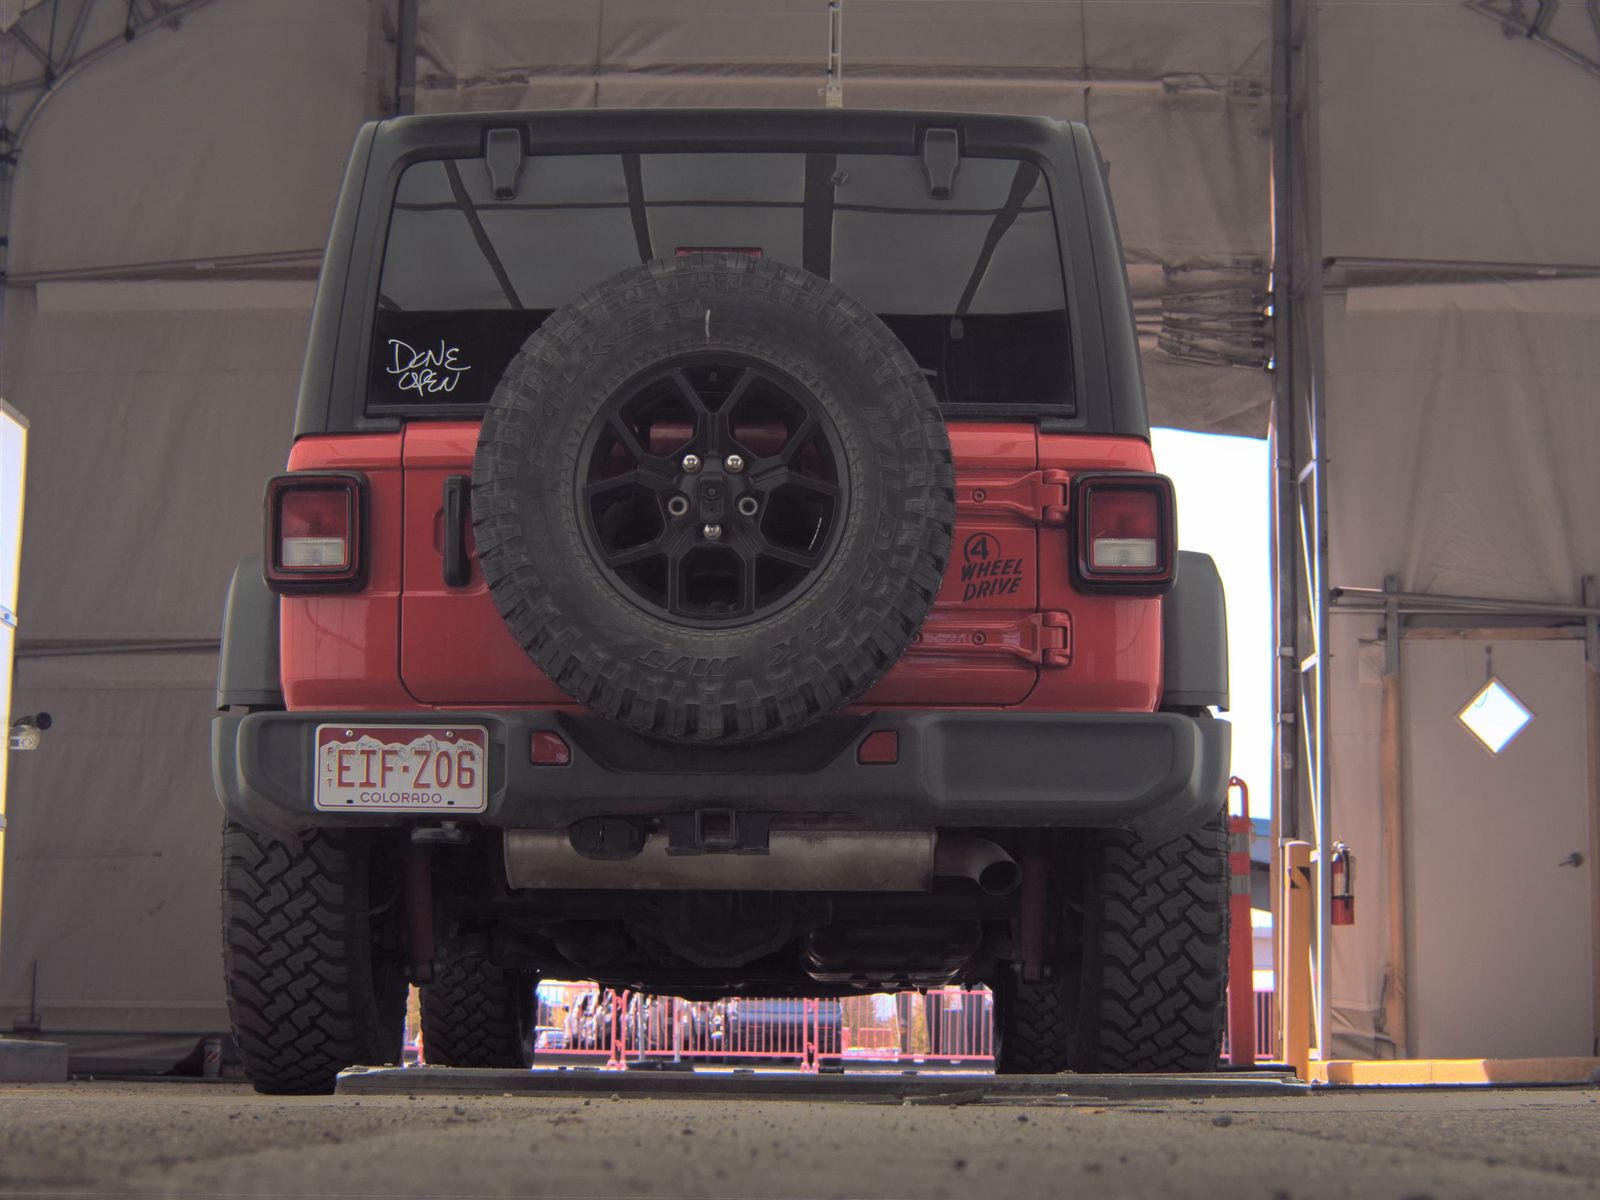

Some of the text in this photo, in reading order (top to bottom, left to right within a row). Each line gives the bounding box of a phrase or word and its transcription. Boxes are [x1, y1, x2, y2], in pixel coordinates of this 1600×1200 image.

[760, 399, 901, 672] WILDPEAK
[970, 537, 989, 560] 4
[961, 558, 1023, 582] WHEEL
[962, 577, 1022, 602] DRIVE
[360, 792, 442, 804] COLORADO
